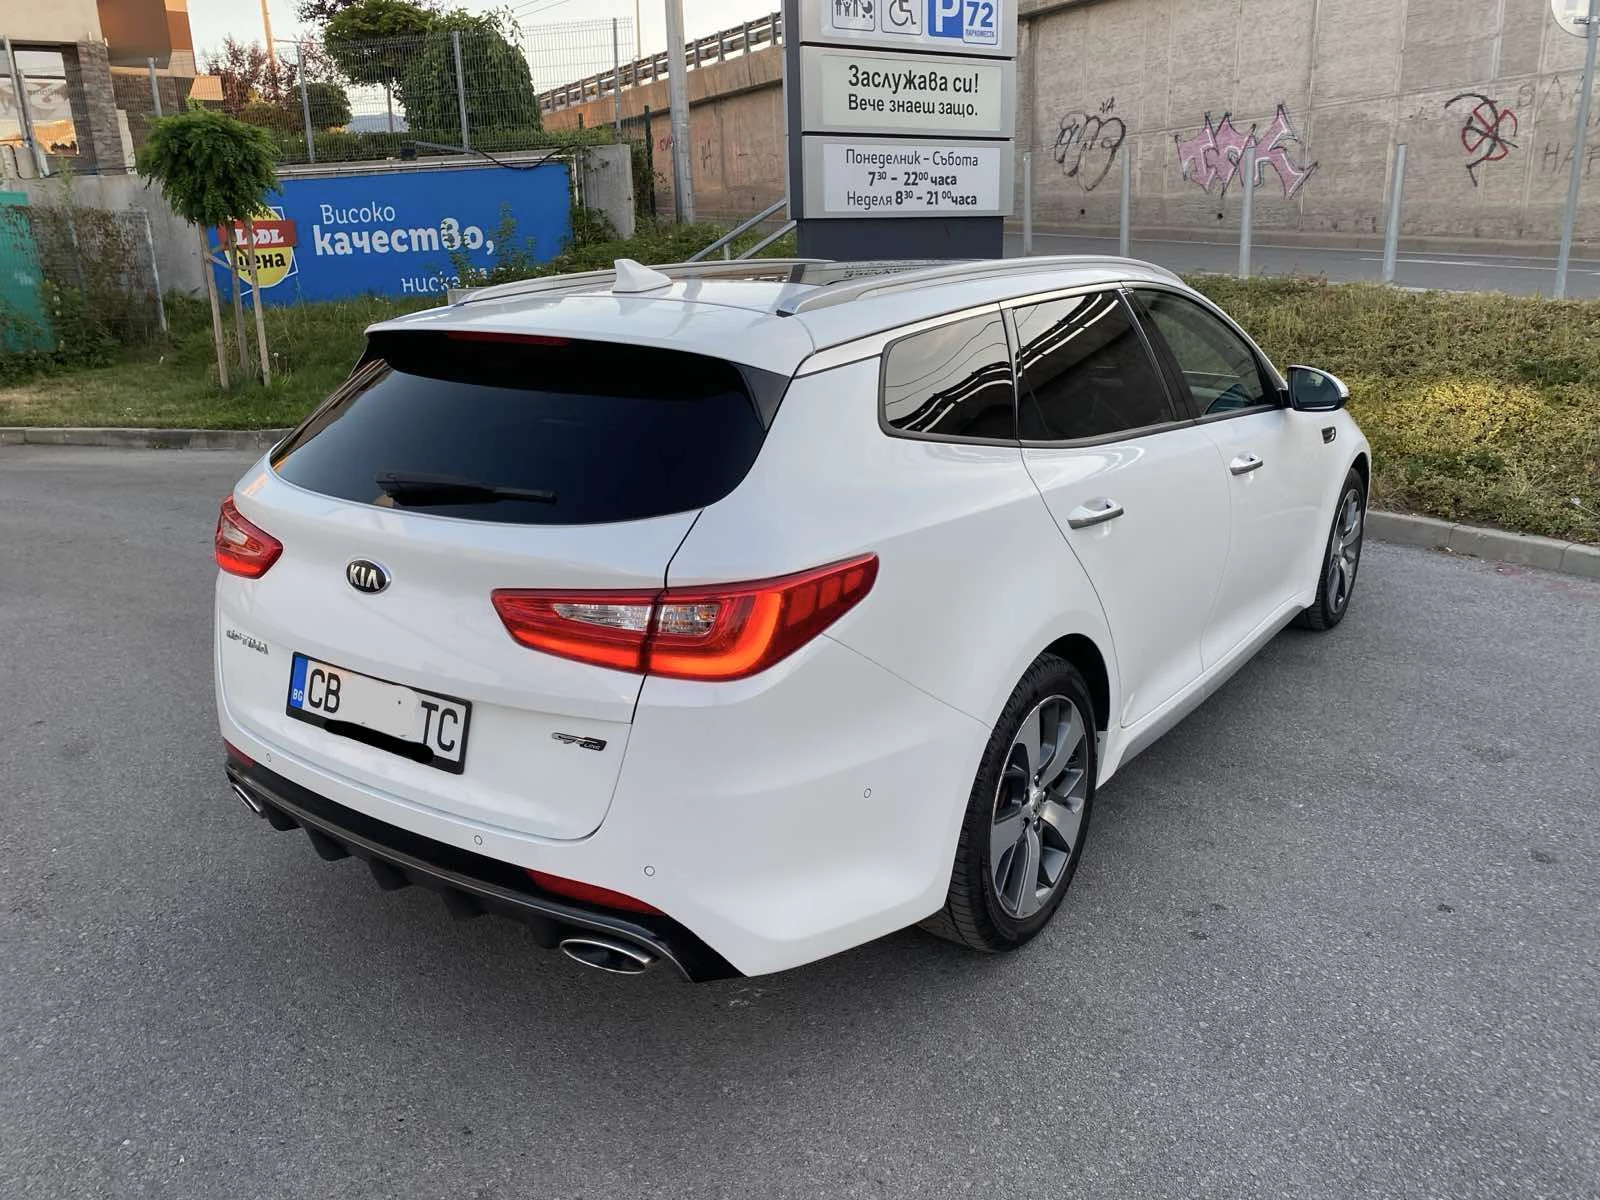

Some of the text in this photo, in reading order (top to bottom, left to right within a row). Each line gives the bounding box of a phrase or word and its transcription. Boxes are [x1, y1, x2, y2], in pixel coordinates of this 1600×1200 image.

[966, 1, 994, 28] 72
[848, 64, 979, 94] Заслужава си!
[848, 94, 978, 118] Вече знаеш защо.
[846, 149, 921, 168] Понеделник
[932, 151, 979, 167] Събота
[930, 174, 957, 186] часа
[847, 191, 893, 210] Неделя
[951, 194, 977, 206] часа
[319, 201, 396, 225] Високо
[313, 217, 496, 256] качество,
[350, 564, 380, 590] KIA
[292, 688, 304, 702] BG
